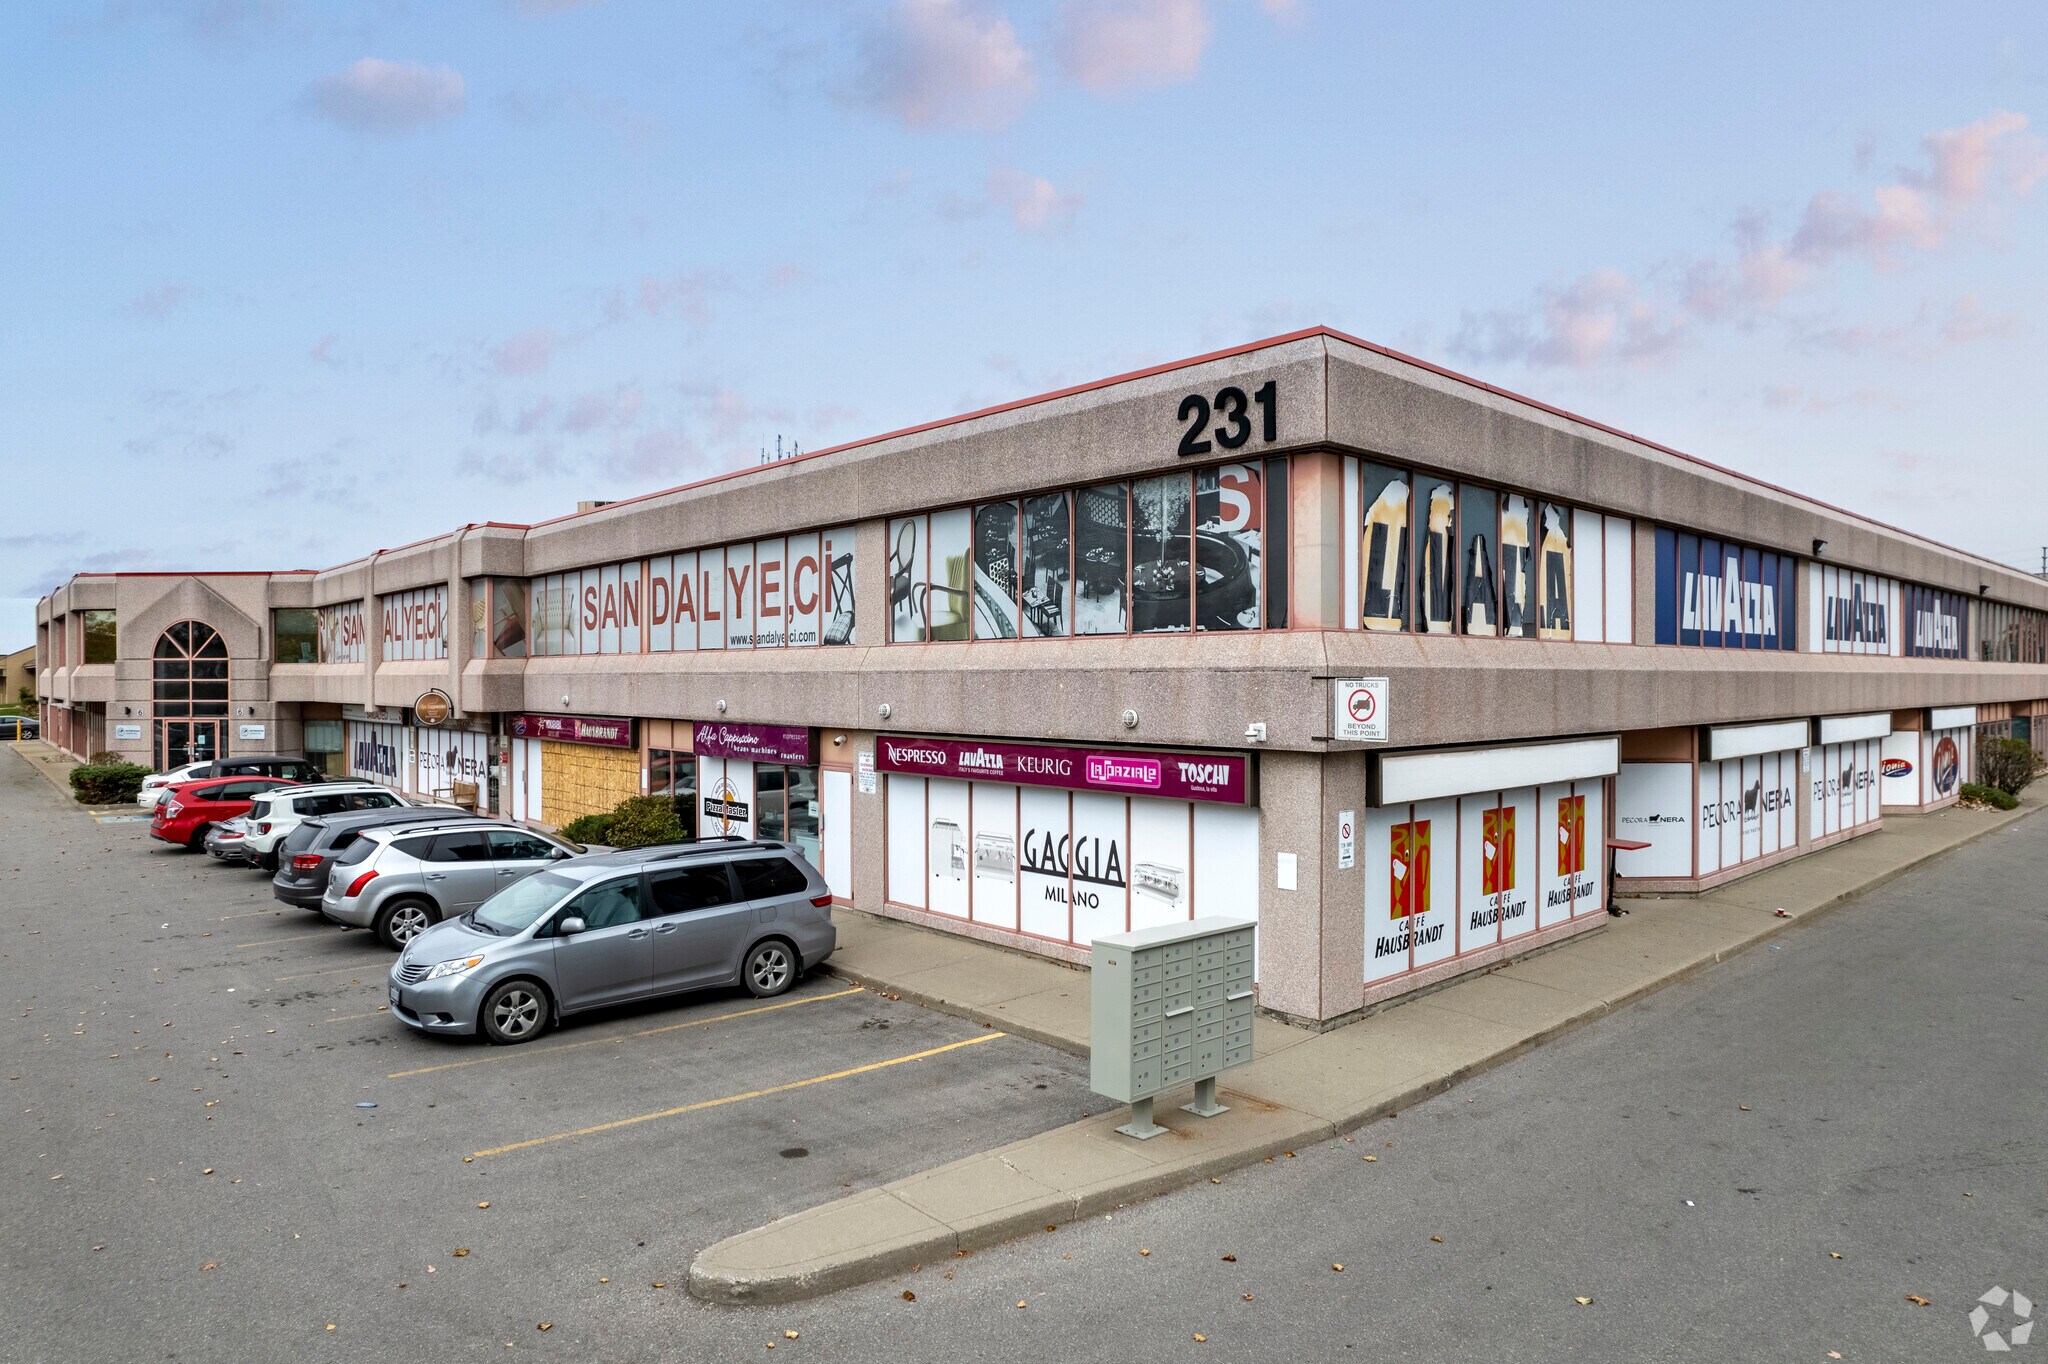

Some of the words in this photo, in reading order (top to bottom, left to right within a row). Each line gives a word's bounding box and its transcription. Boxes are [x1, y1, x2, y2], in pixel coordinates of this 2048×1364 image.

[1178, 380, 1277, 456] 231
[1682, 556, 1776, 637] LAVAZZA
[1826, 583, 1887, 644] LAVAZZA
[697, 725, 717, 747] Alfa
[719, 726, 759, 749] Cappuccino
[733, 744, 749, 753] beans
[751, 746, 777, 755] machines
[885, 742, 947, 766] NESPRESSO
[958, 747, 1004, 769] LAVAZZA
[1018, 757, 1071, 776] KEURIG
[457, 757, 486, 778] NERA
[1178, 762, 1229, 785] TOSCHI
[1703, 800, 1741, 829] PECORA
[1761, 787, 1792, 813] NERA
[1024, 828, 1123, 882] GAGGIA
[1547, 882, 1595, 908] HAUSBRANDT
[1470, 901, 1527, 931] HAUSBRANDT
[1375, 924, 1445, 959] HAUSBRANDT
